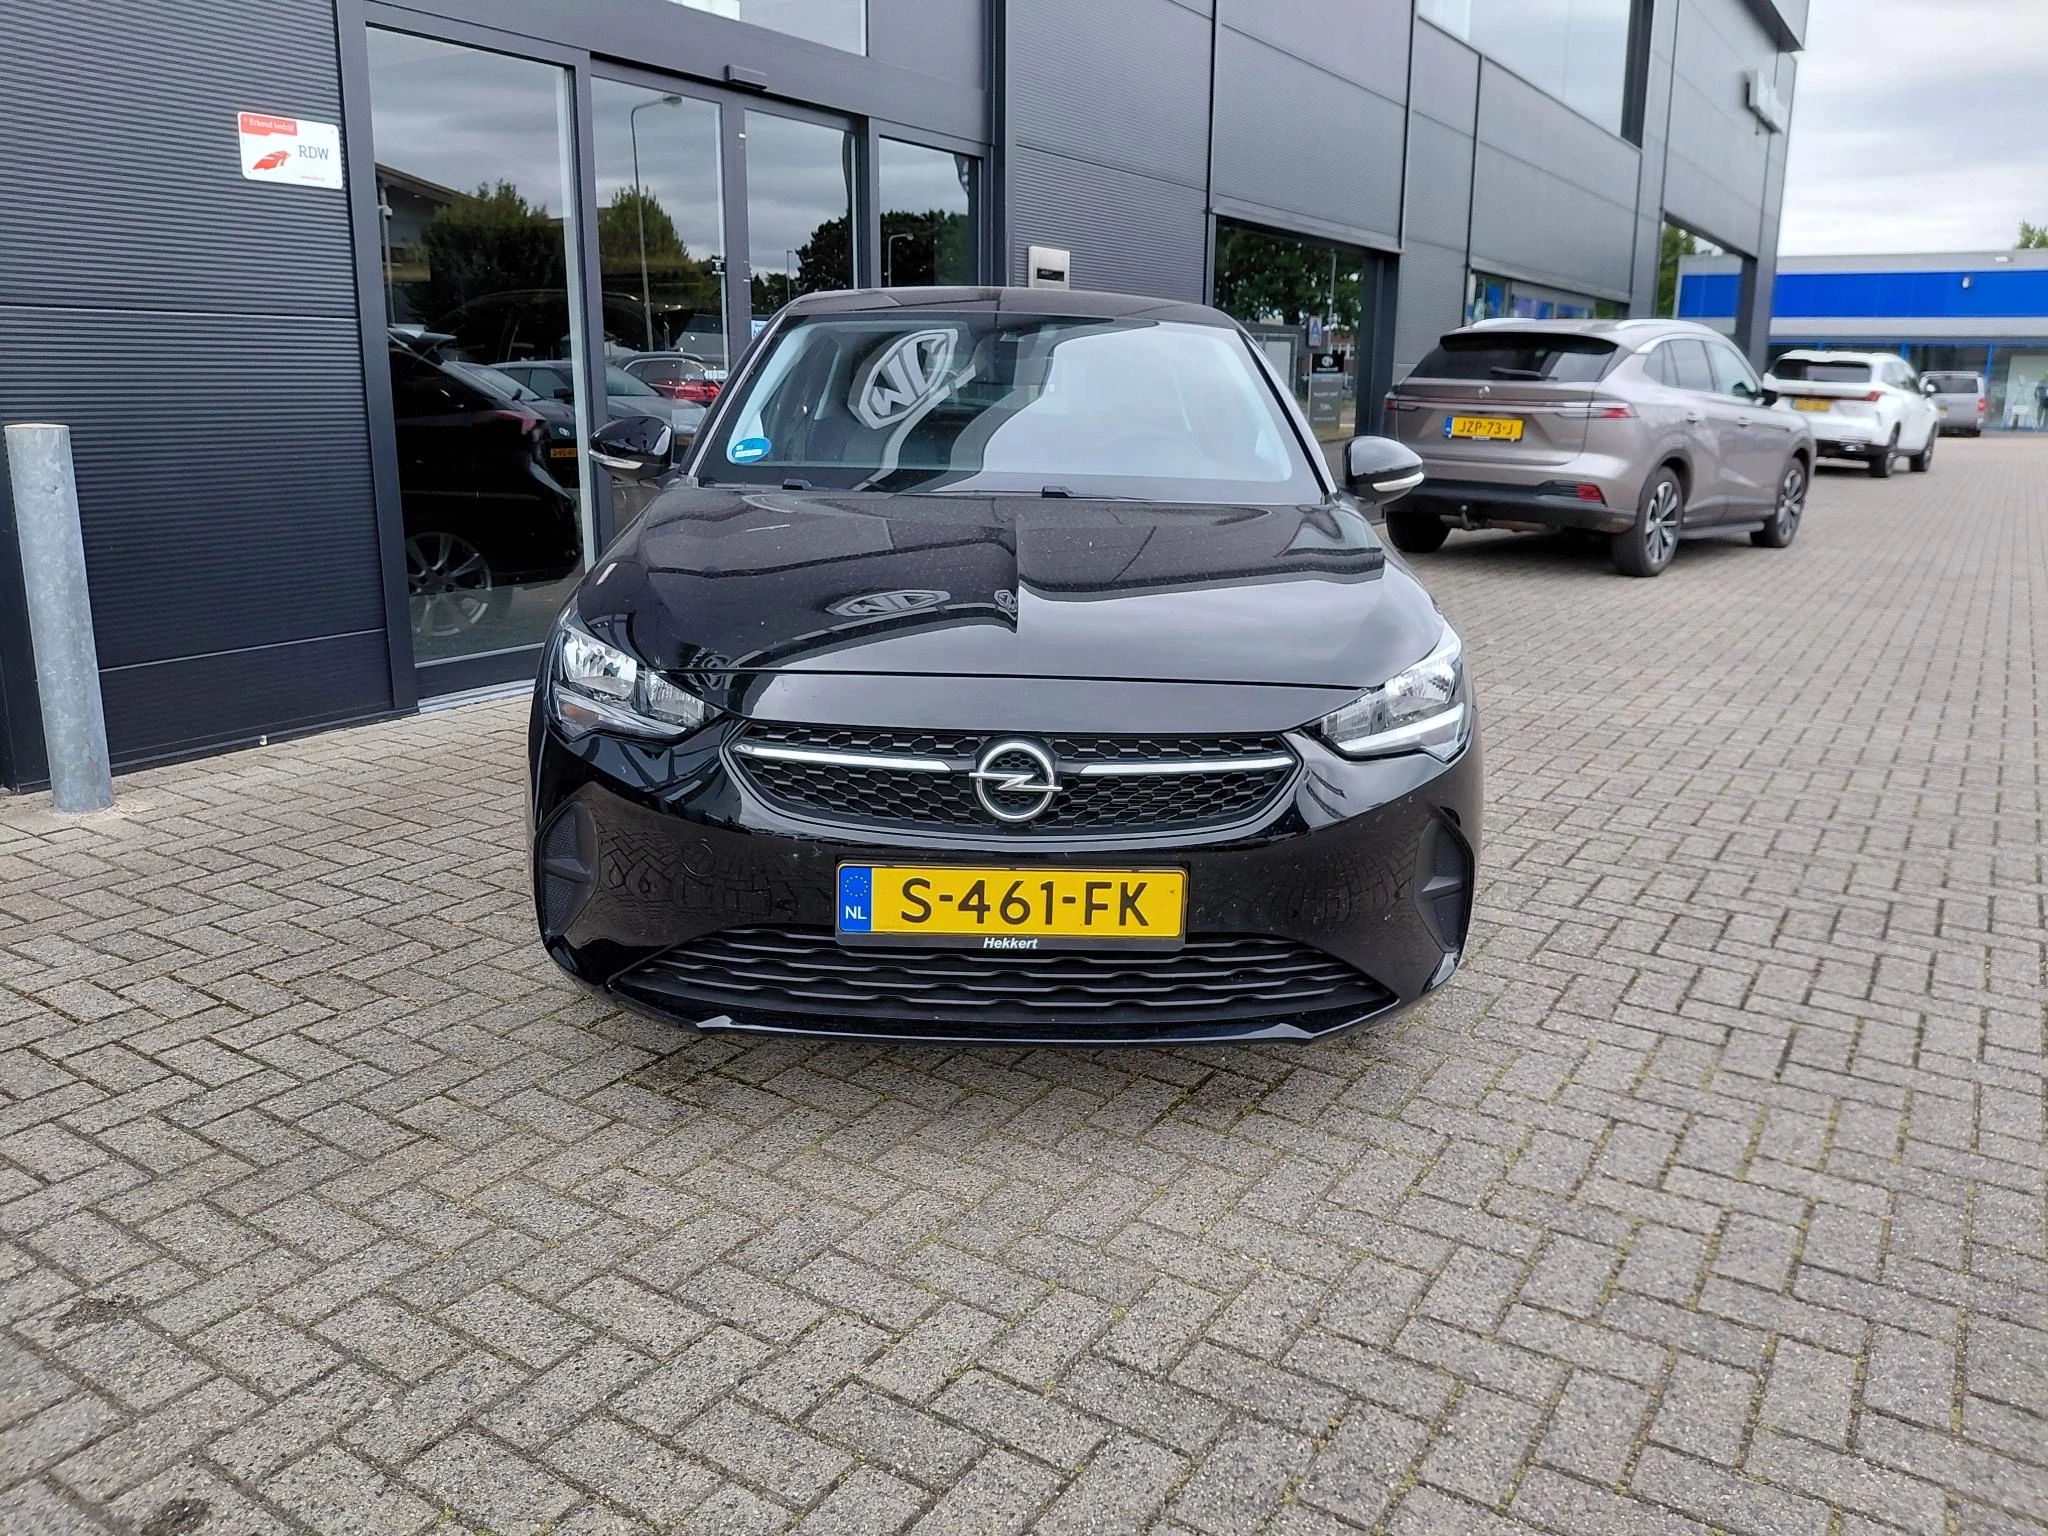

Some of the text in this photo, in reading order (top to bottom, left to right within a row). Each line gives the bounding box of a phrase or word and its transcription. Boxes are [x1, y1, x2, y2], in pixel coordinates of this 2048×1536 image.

[298, 145, 329, 160] RDW
[1459, 420, 1514, 436] JZP-73-J
[901, 877, 1149, 927] S-461-FK
[845, 905, 867, 920] NL
[983, 937, 1039, 949] Hekkert
